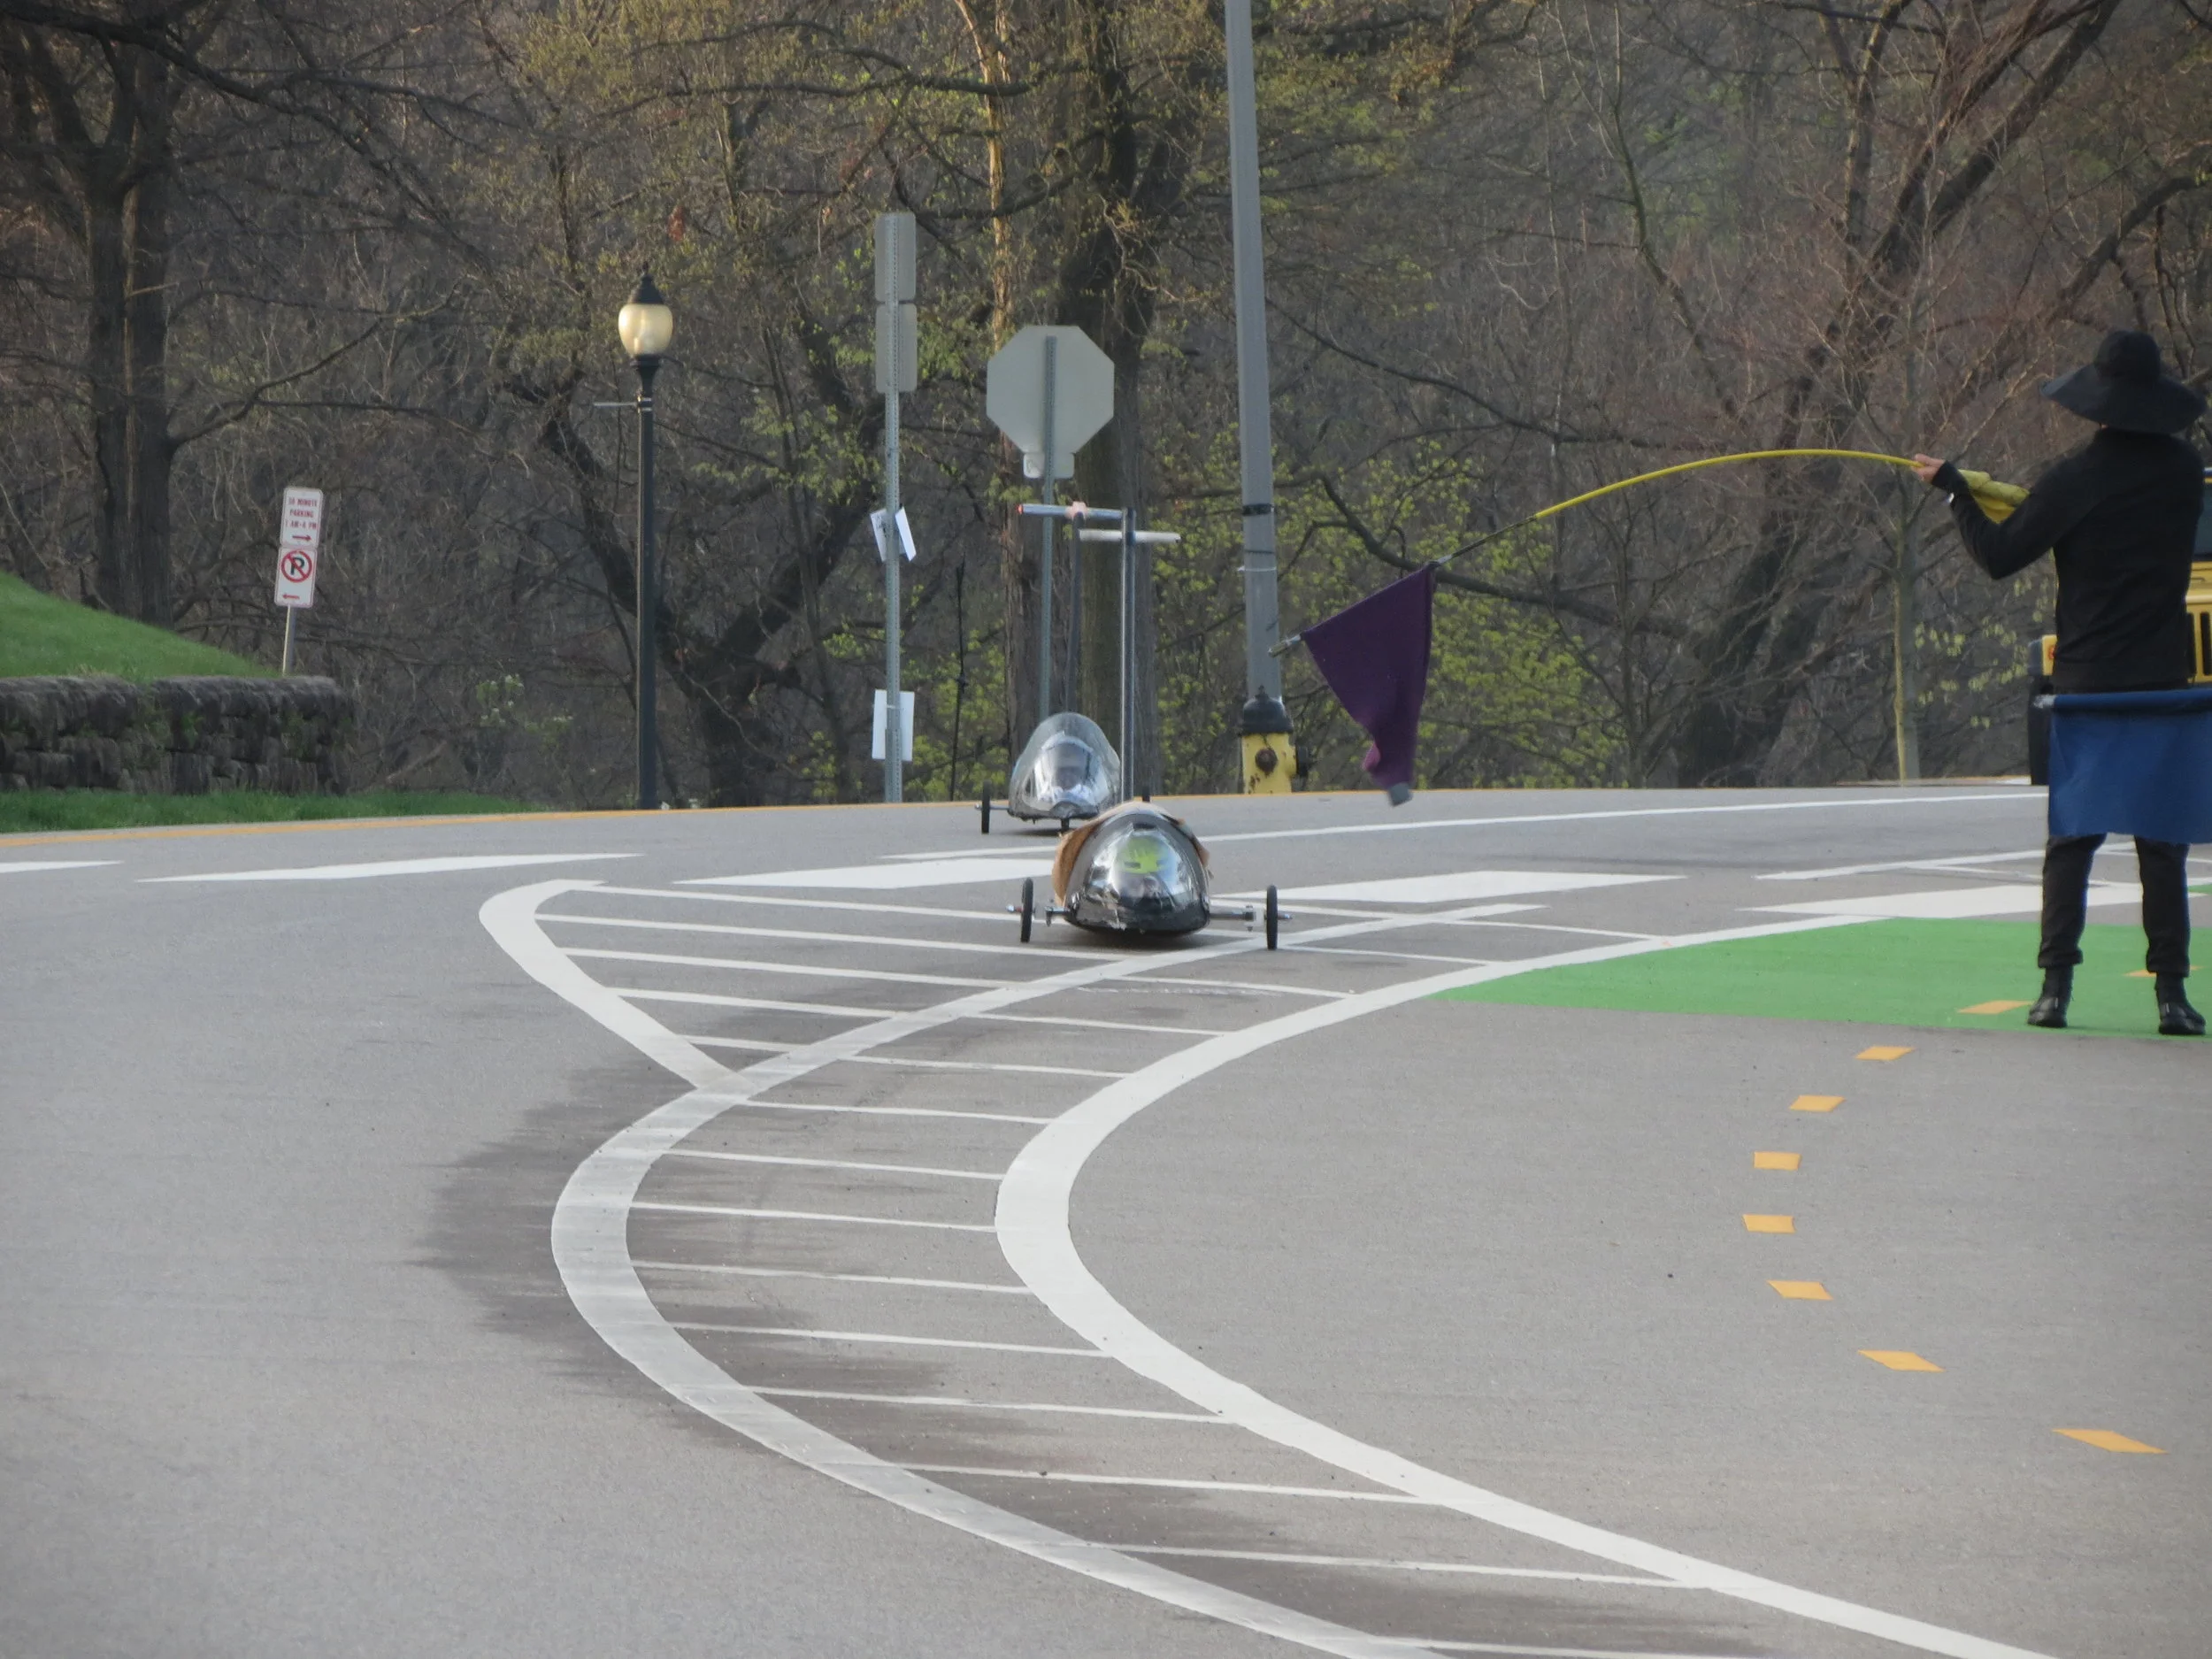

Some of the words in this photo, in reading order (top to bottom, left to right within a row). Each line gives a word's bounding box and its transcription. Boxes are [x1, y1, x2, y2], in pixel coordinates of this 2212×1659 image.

[297, 498, 317, 507] MINUTE
[290, 509, 313, 518] PARKING
[308, 521, 317, 530] PM
[291, 557, 305, 575] P
